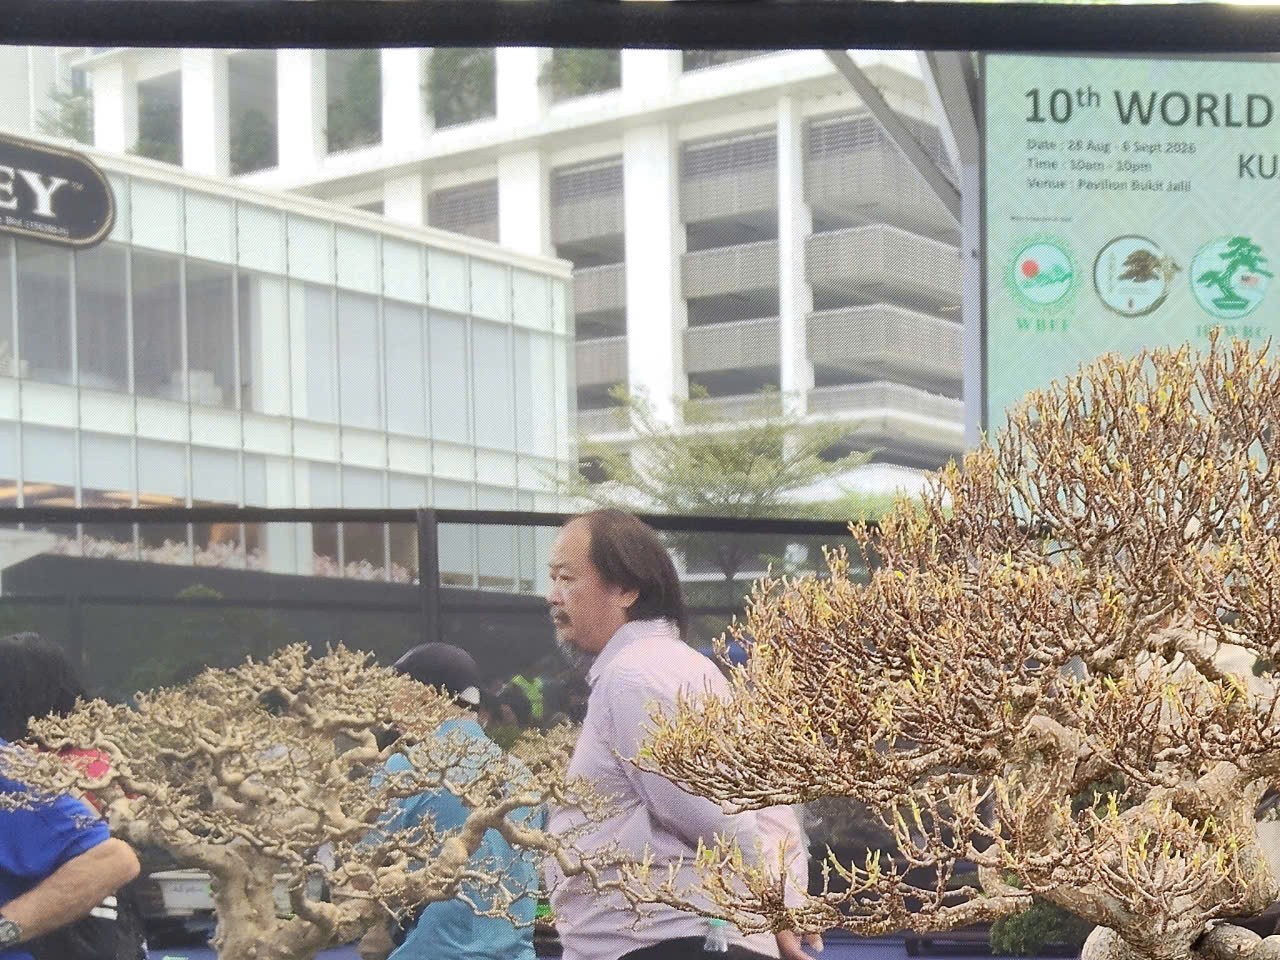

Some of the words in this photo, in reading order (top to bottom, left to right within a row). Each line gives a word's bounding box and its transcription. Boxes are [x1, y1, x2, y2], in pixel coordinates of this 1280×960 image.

[1025, 86, 1100, 124] 10th
[1113, 90, 1274, 128] WORLD
[1027, 139, 1056, 150] Date
[1087, 139, 1111, 154] Aug
[1133, 141, 1162, 155] Sept
[1165, 142, 1196, 153] 2026
[1027, 158, 1057, 170] Time
[1070, 159, 1104, 172] 10am
[1027, 178, 1065, 189] Venue
[1078, 179, 1128, 191] Pavilion
